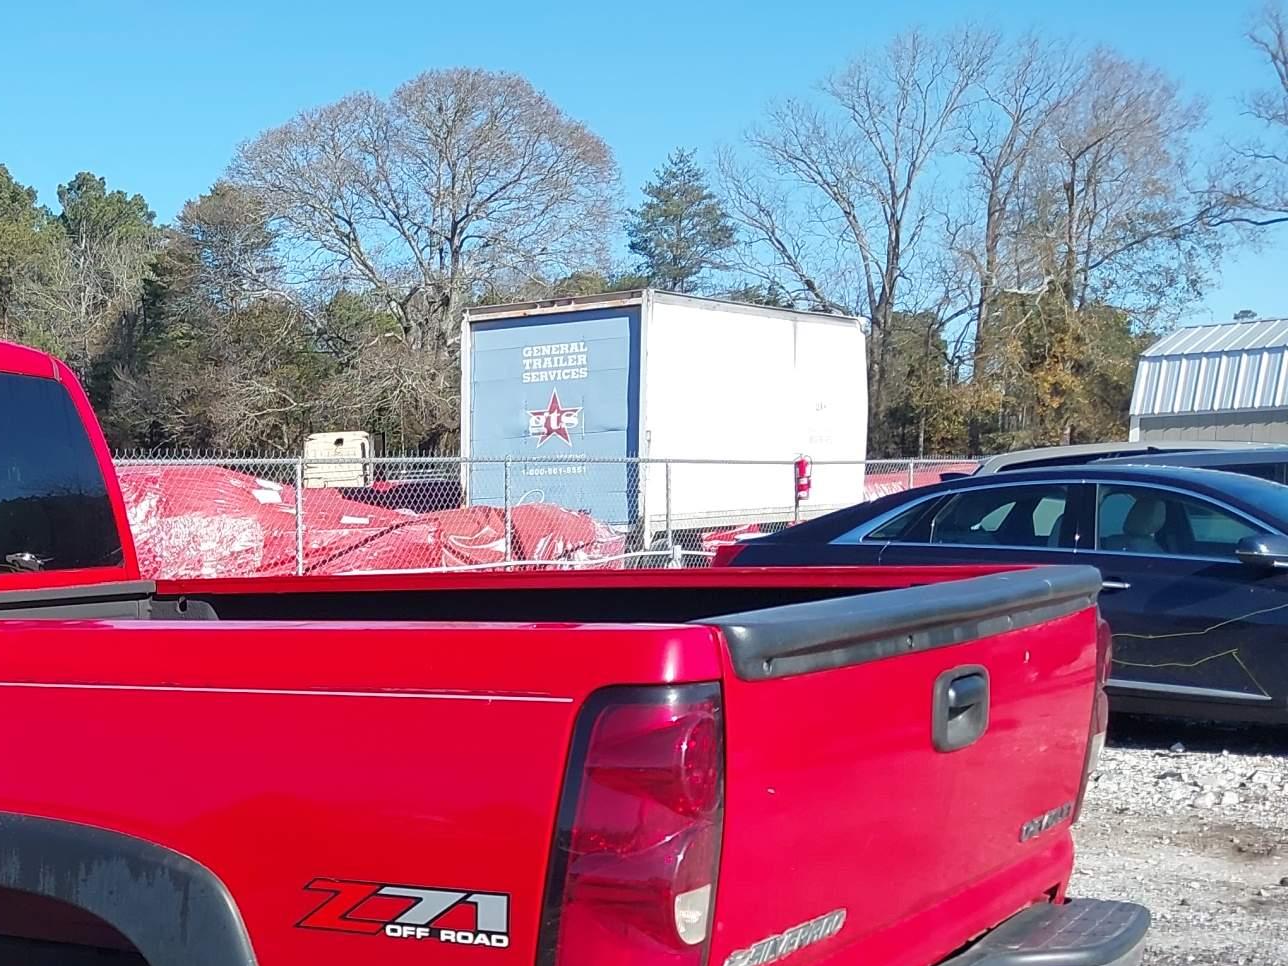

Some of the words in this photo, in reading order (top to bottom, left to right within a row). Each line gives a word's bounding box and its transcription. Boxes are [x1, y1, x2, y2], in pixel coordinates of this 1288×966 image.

[522, 341, 588, 358] GENERAL
[522, 354, 587, 370] TRAILER
[522, 367, 588, 383] SERVICES
[294, 877, 511, 936] Z71
[385, 924, 430, 940] OFF
[439, 929, 509, 948] ROAD
